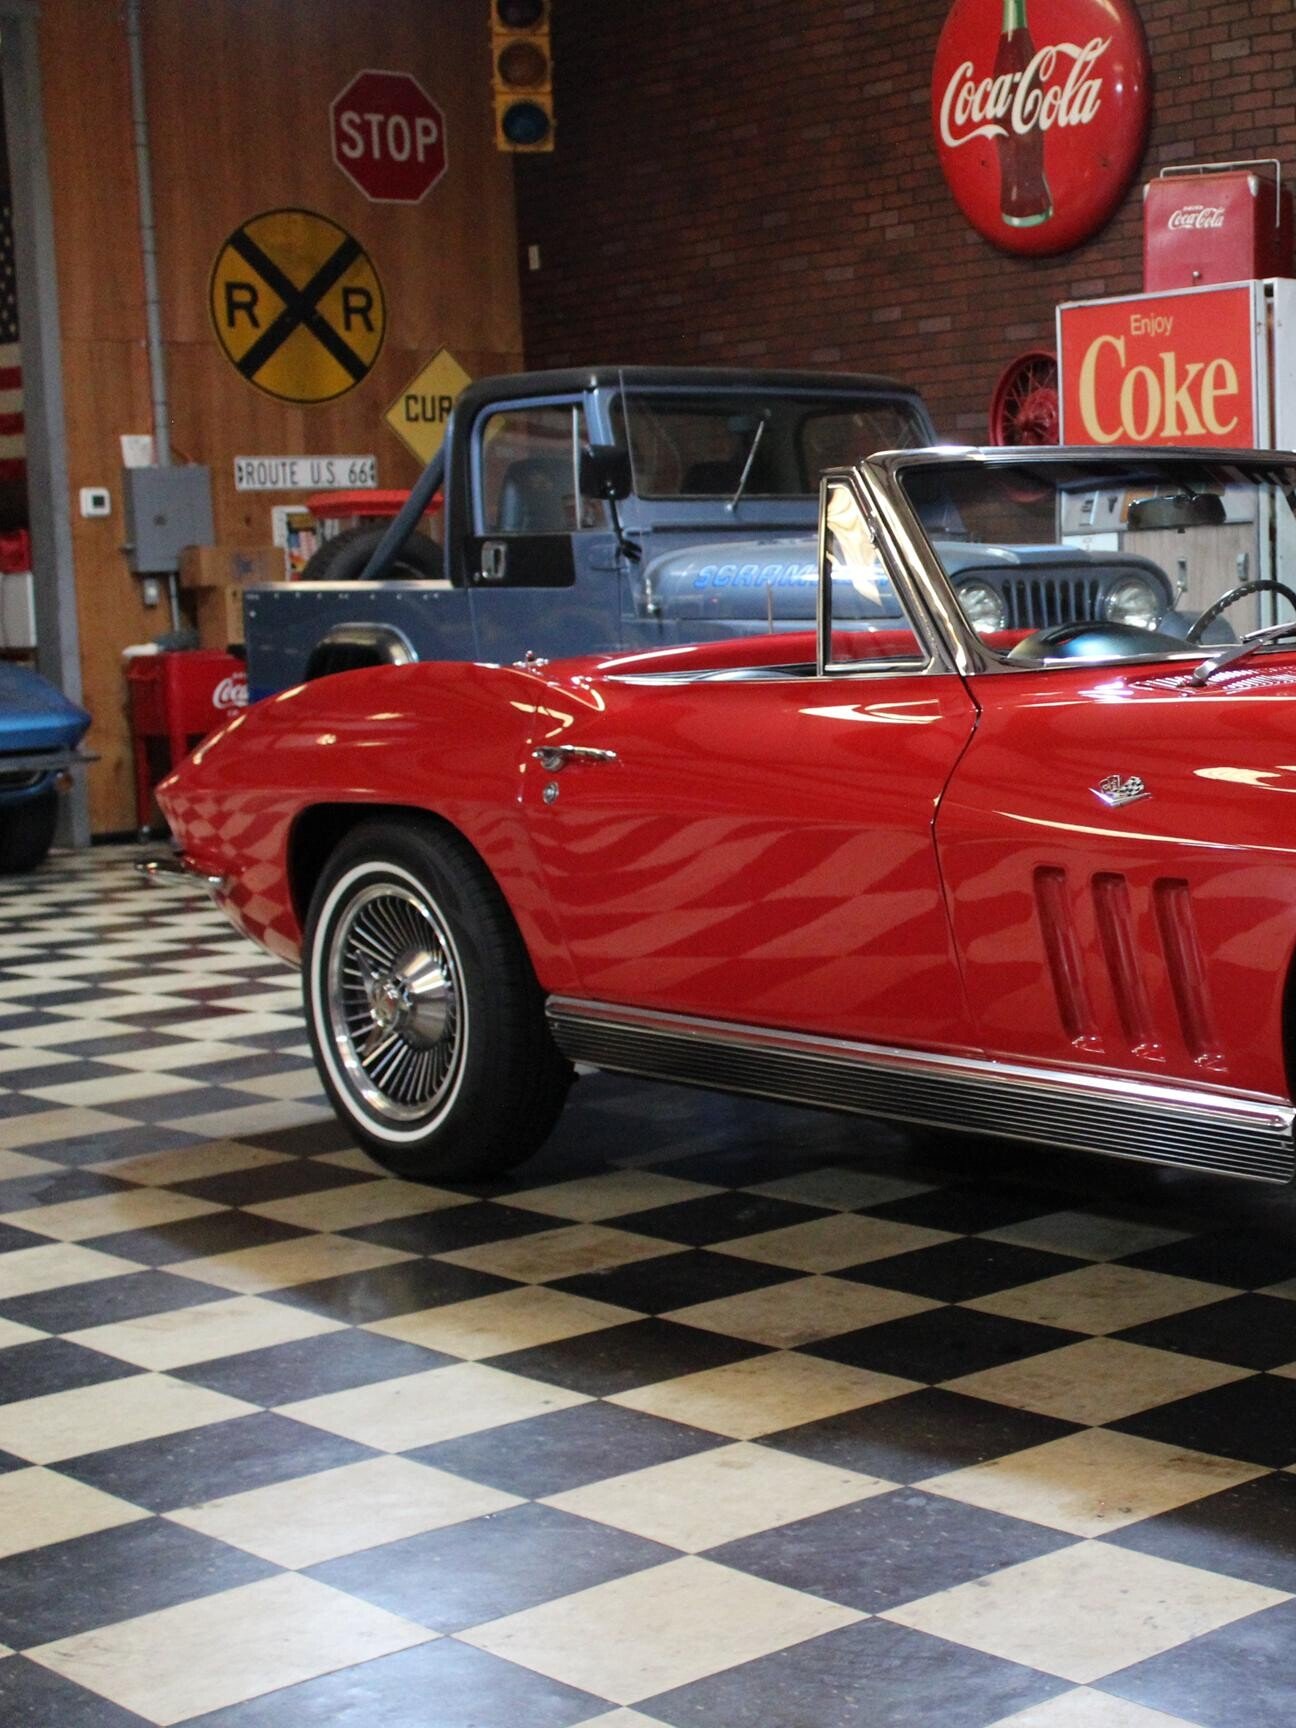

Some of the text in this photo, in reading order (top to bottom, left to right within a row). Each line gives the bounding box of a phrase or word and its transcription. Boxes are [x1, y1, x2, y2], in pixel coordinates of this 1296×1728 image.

[941, 36, 1112, 148] Coca-Cola
[340, 111, 439, 162] STOP
[1130, 312, 1174, 337] Enjoy
[405, 394, 453, 423] CUR
[1078, 335, 1240, 445] Coke
[245, 461, 298, 485] ROUTE
[348, 461, 368, 484] 66
